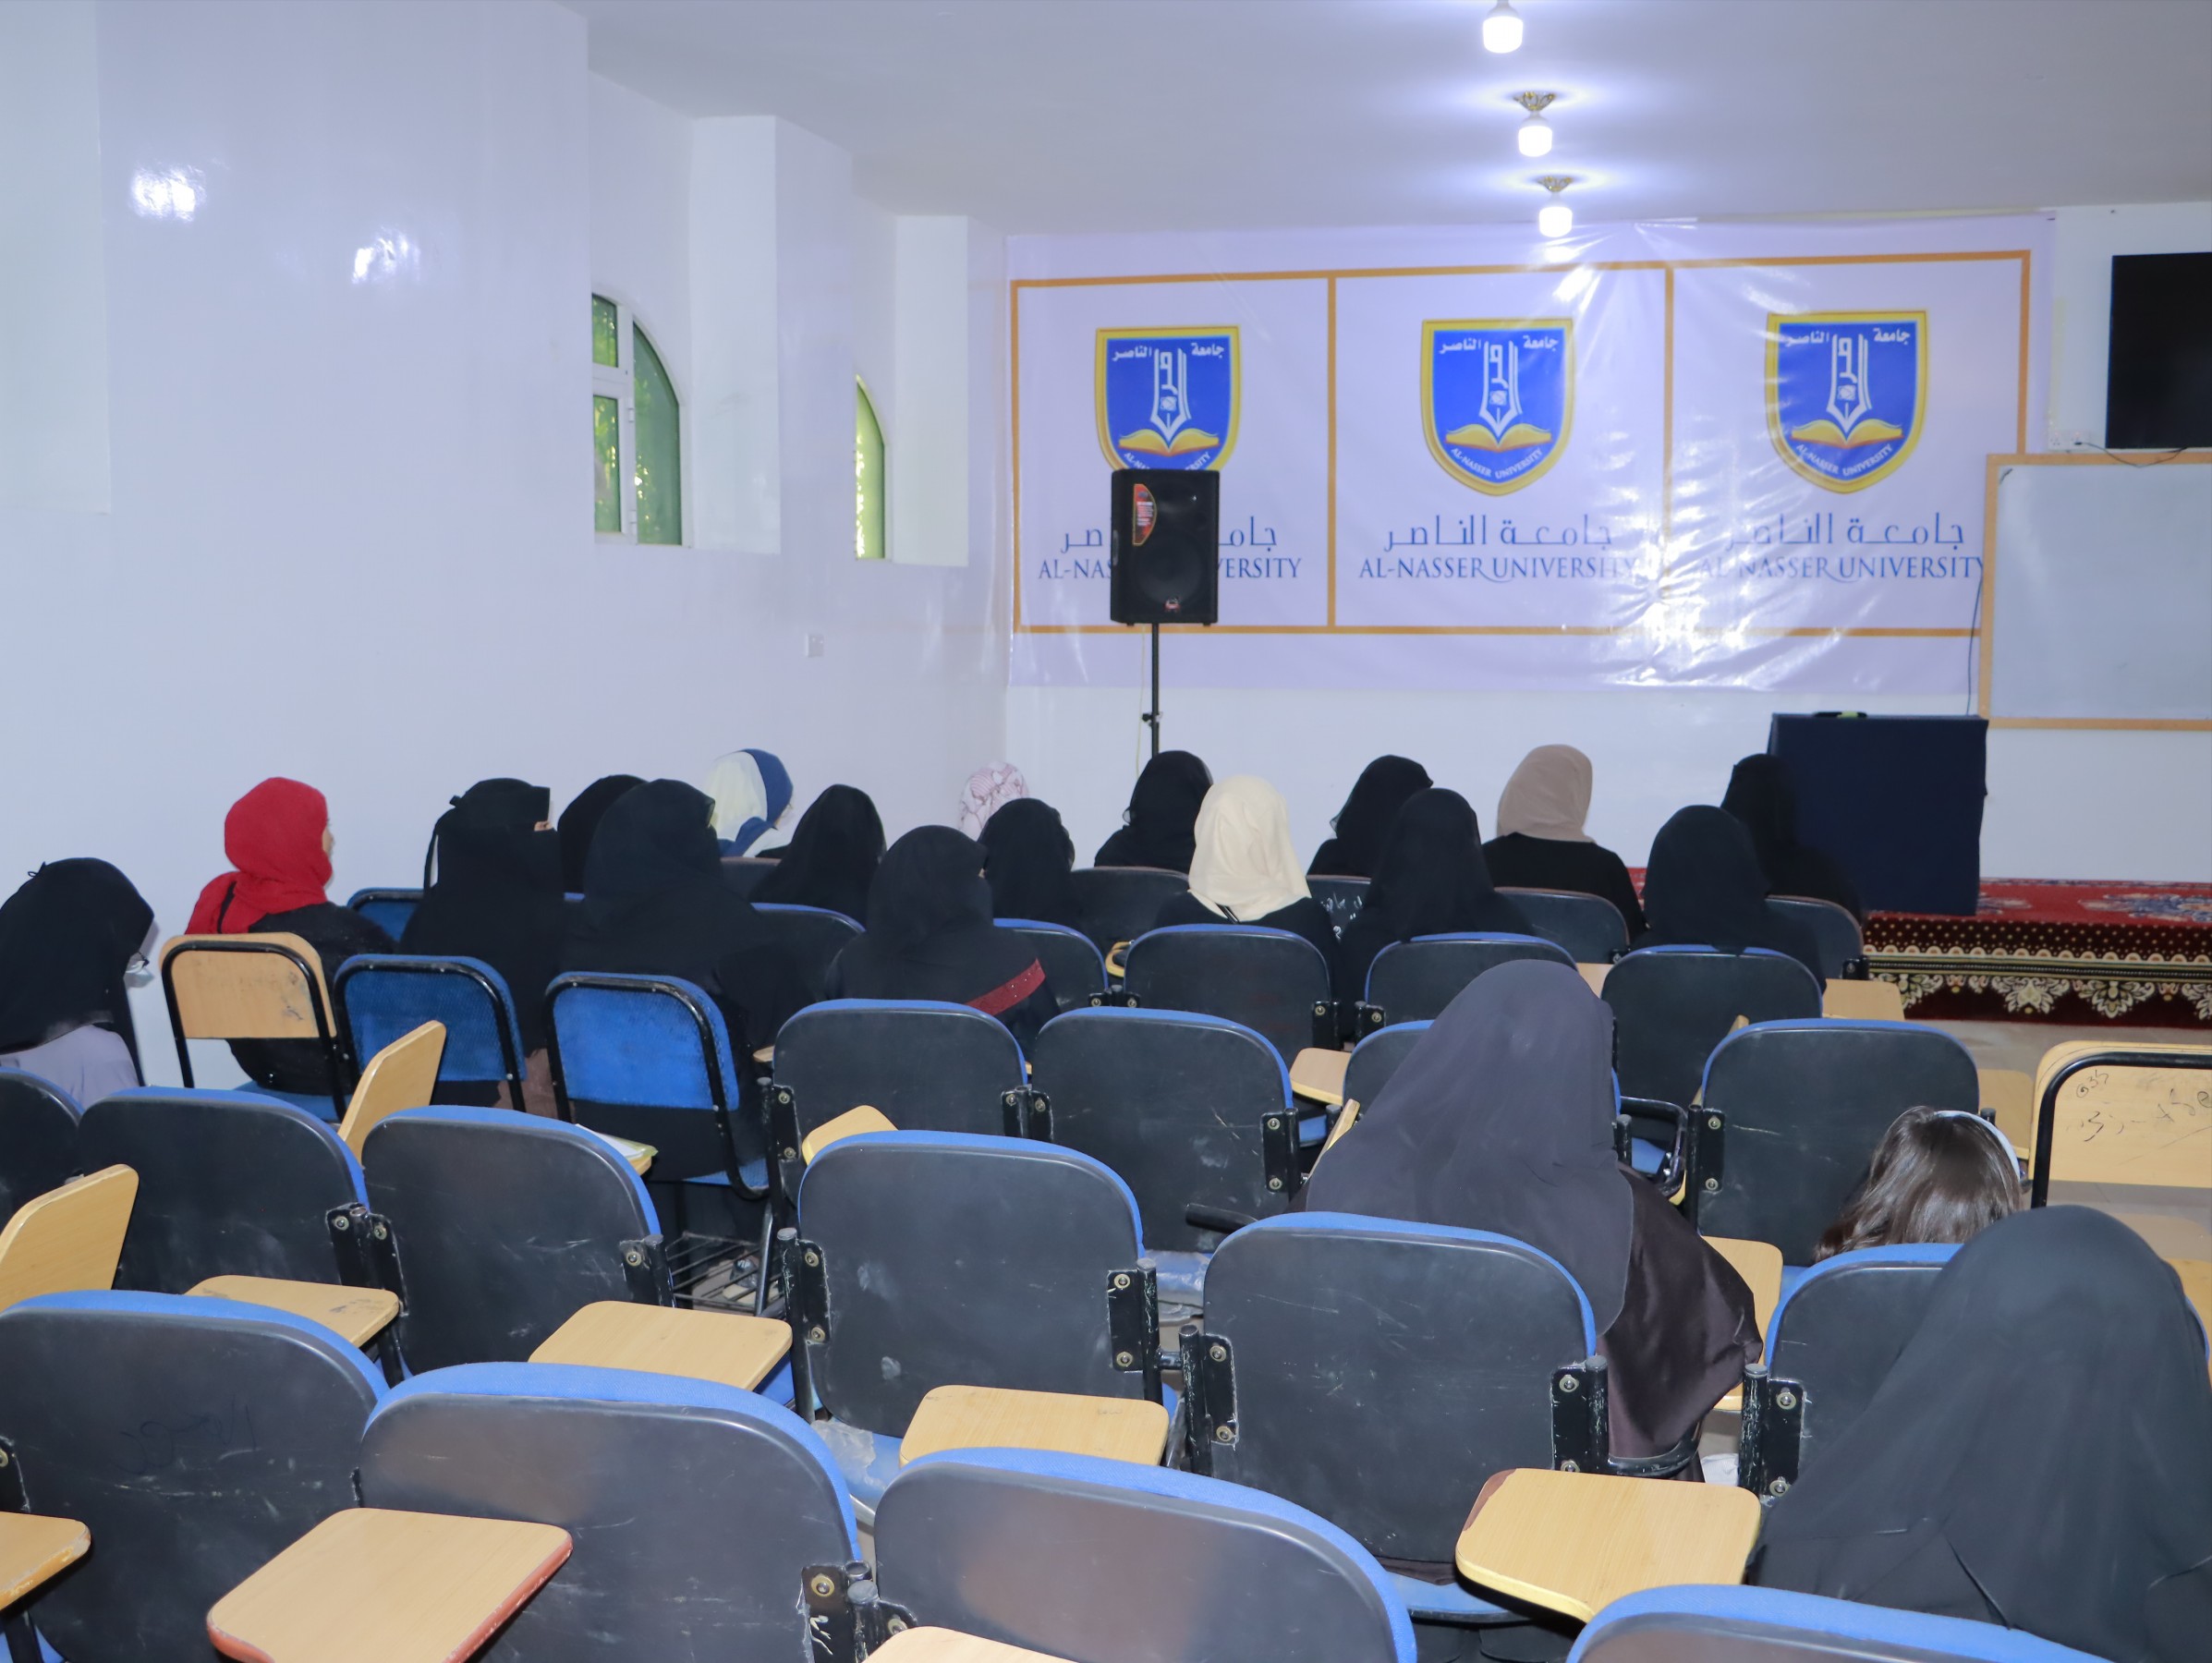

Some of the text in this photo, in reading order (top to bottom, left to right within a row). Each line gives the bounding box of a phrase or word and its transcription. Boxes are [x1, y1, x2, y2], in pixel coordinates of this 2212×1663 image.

[1440, 334, 1559, 354] جامعة الناصر
[1873, 327, 1911, 346] جامعة
[1112, 342, 1224, 361] جامعة الناصر
[1451, 447, 1542, 479] AL-NASSER UNIVERSITY
[1842, 443, 1892, 477] UNIVERSITY
[1384, 514, 1612, 552] جامعة الناصر
[1848, 512, 1963, 551] جامعة
[1359, 557, 1637, 583] AL-NASSER UNIVERSITY
